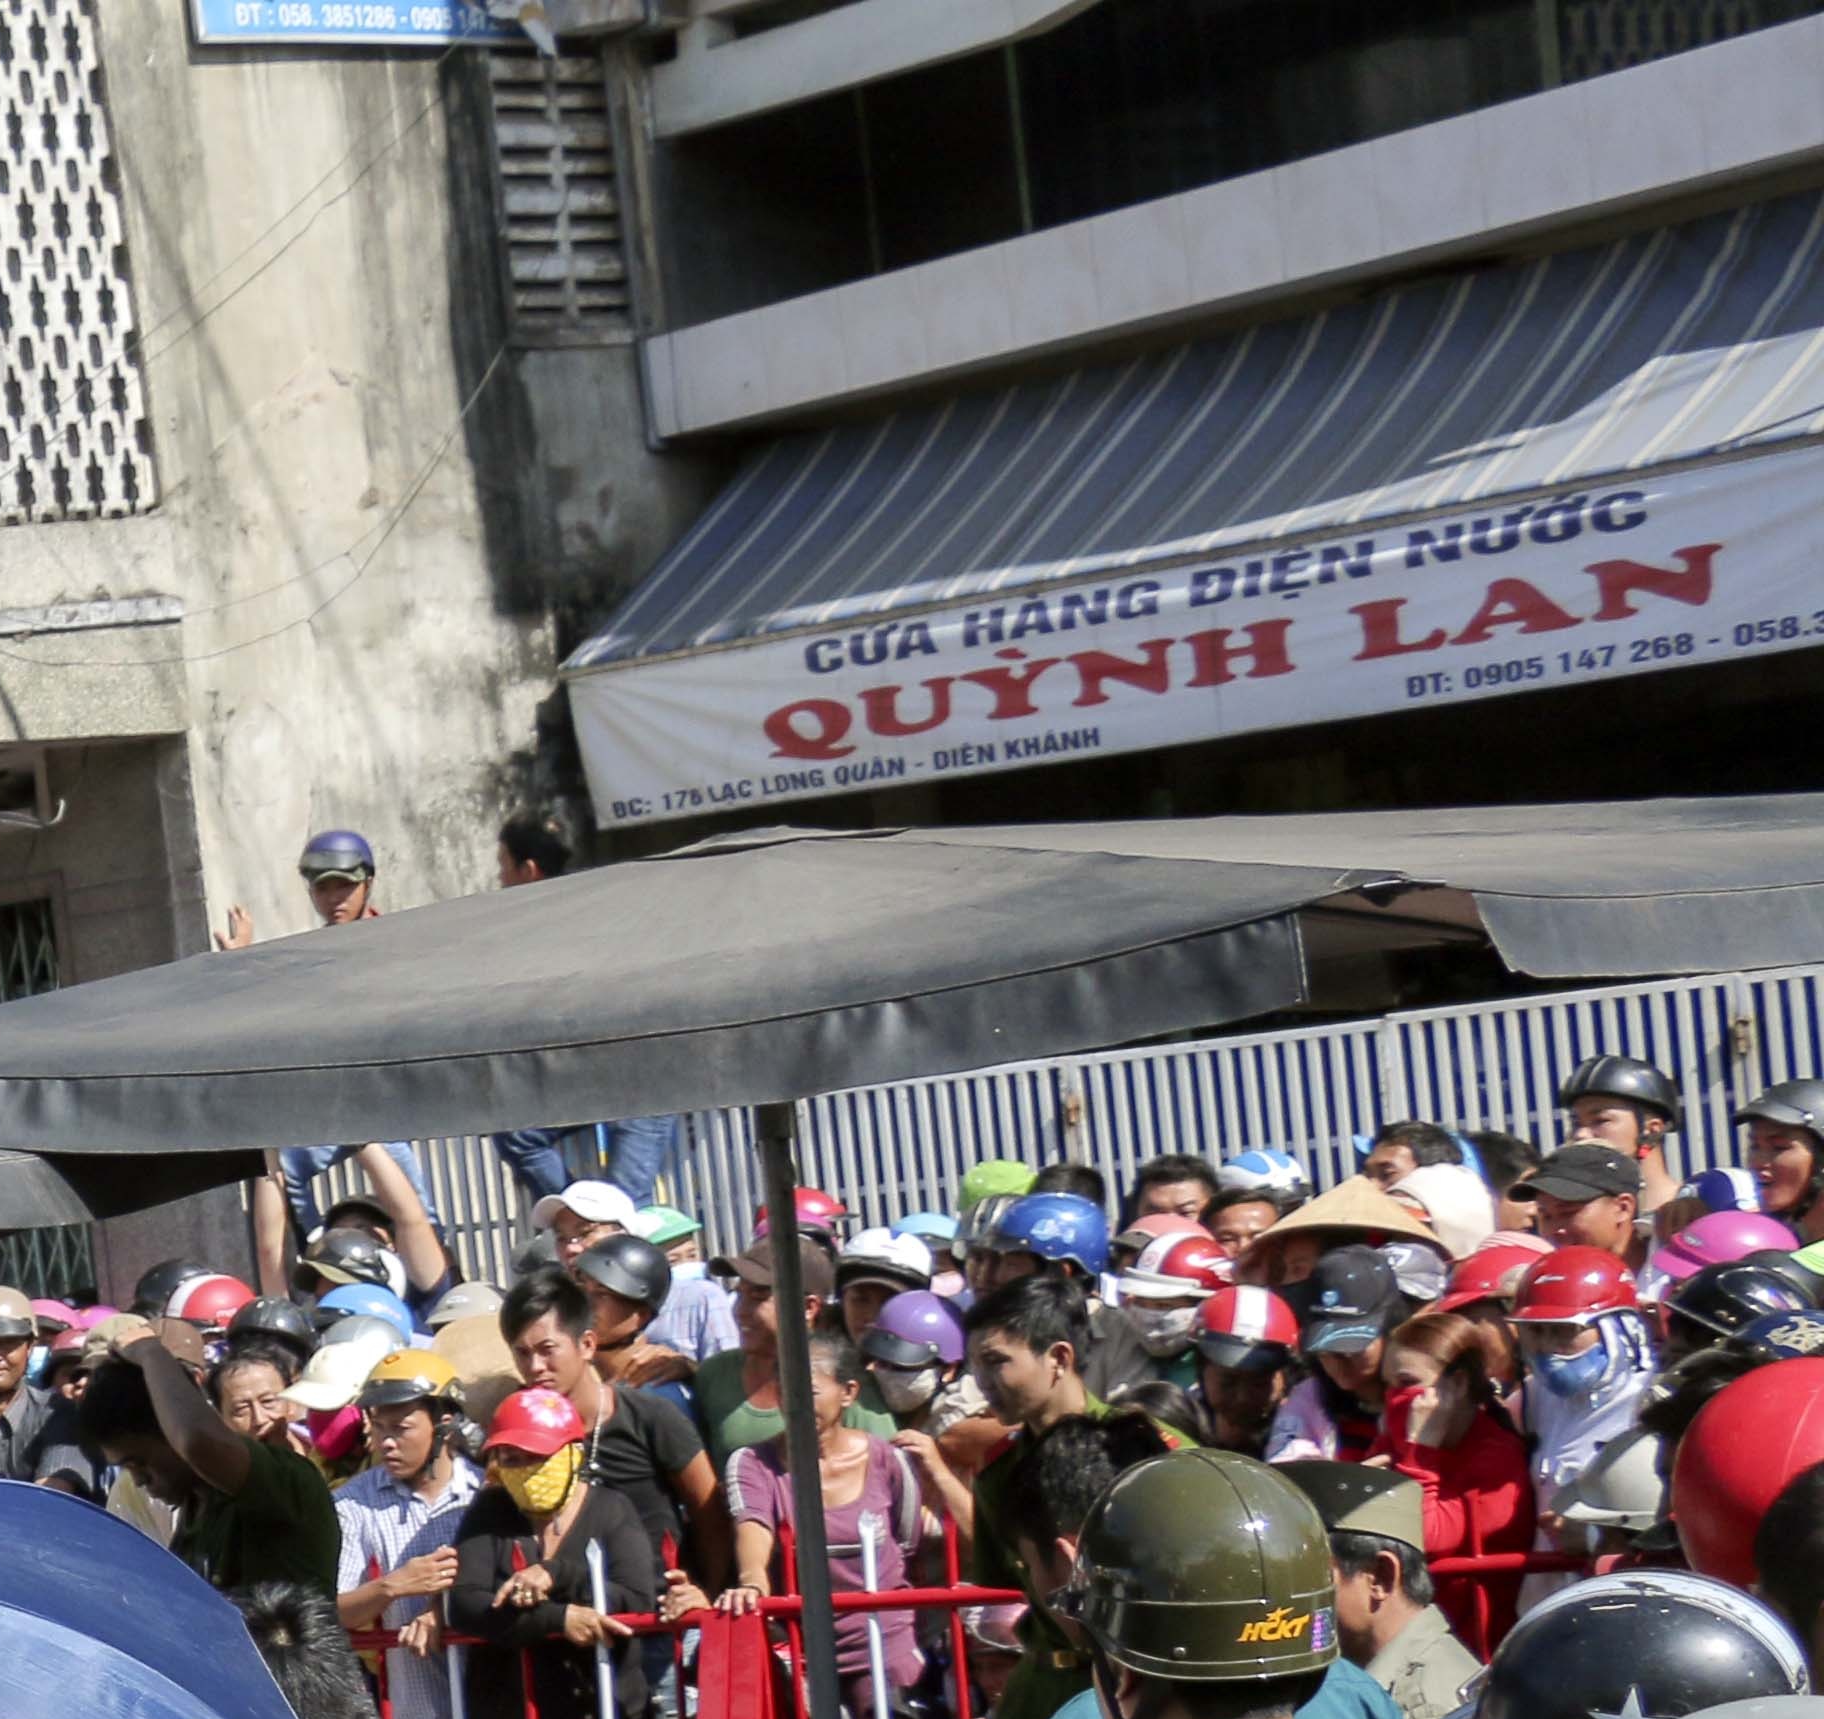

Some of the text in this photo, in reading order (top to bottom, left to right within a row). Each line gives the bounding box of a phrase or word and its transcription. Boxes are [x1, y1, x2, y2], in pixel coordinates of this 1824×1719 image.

[805, 490, 1649, 674] CỬA HÀNG ĐIỆN NƯỚC
[761, 542, 1725, 761] QUỲNH LAN
[1406, 671, 1453, 699] ĐT:
[1463, 657, 1545, 690] 0905
[1558, 645, 1617, 674] 147
[1630, 631, 1695, 664] 268
[761, 767, 826, 796] LONG
[834, 756, 906, 788] QUÂN
[1004, 725, 1102, 761] KHÁNH
